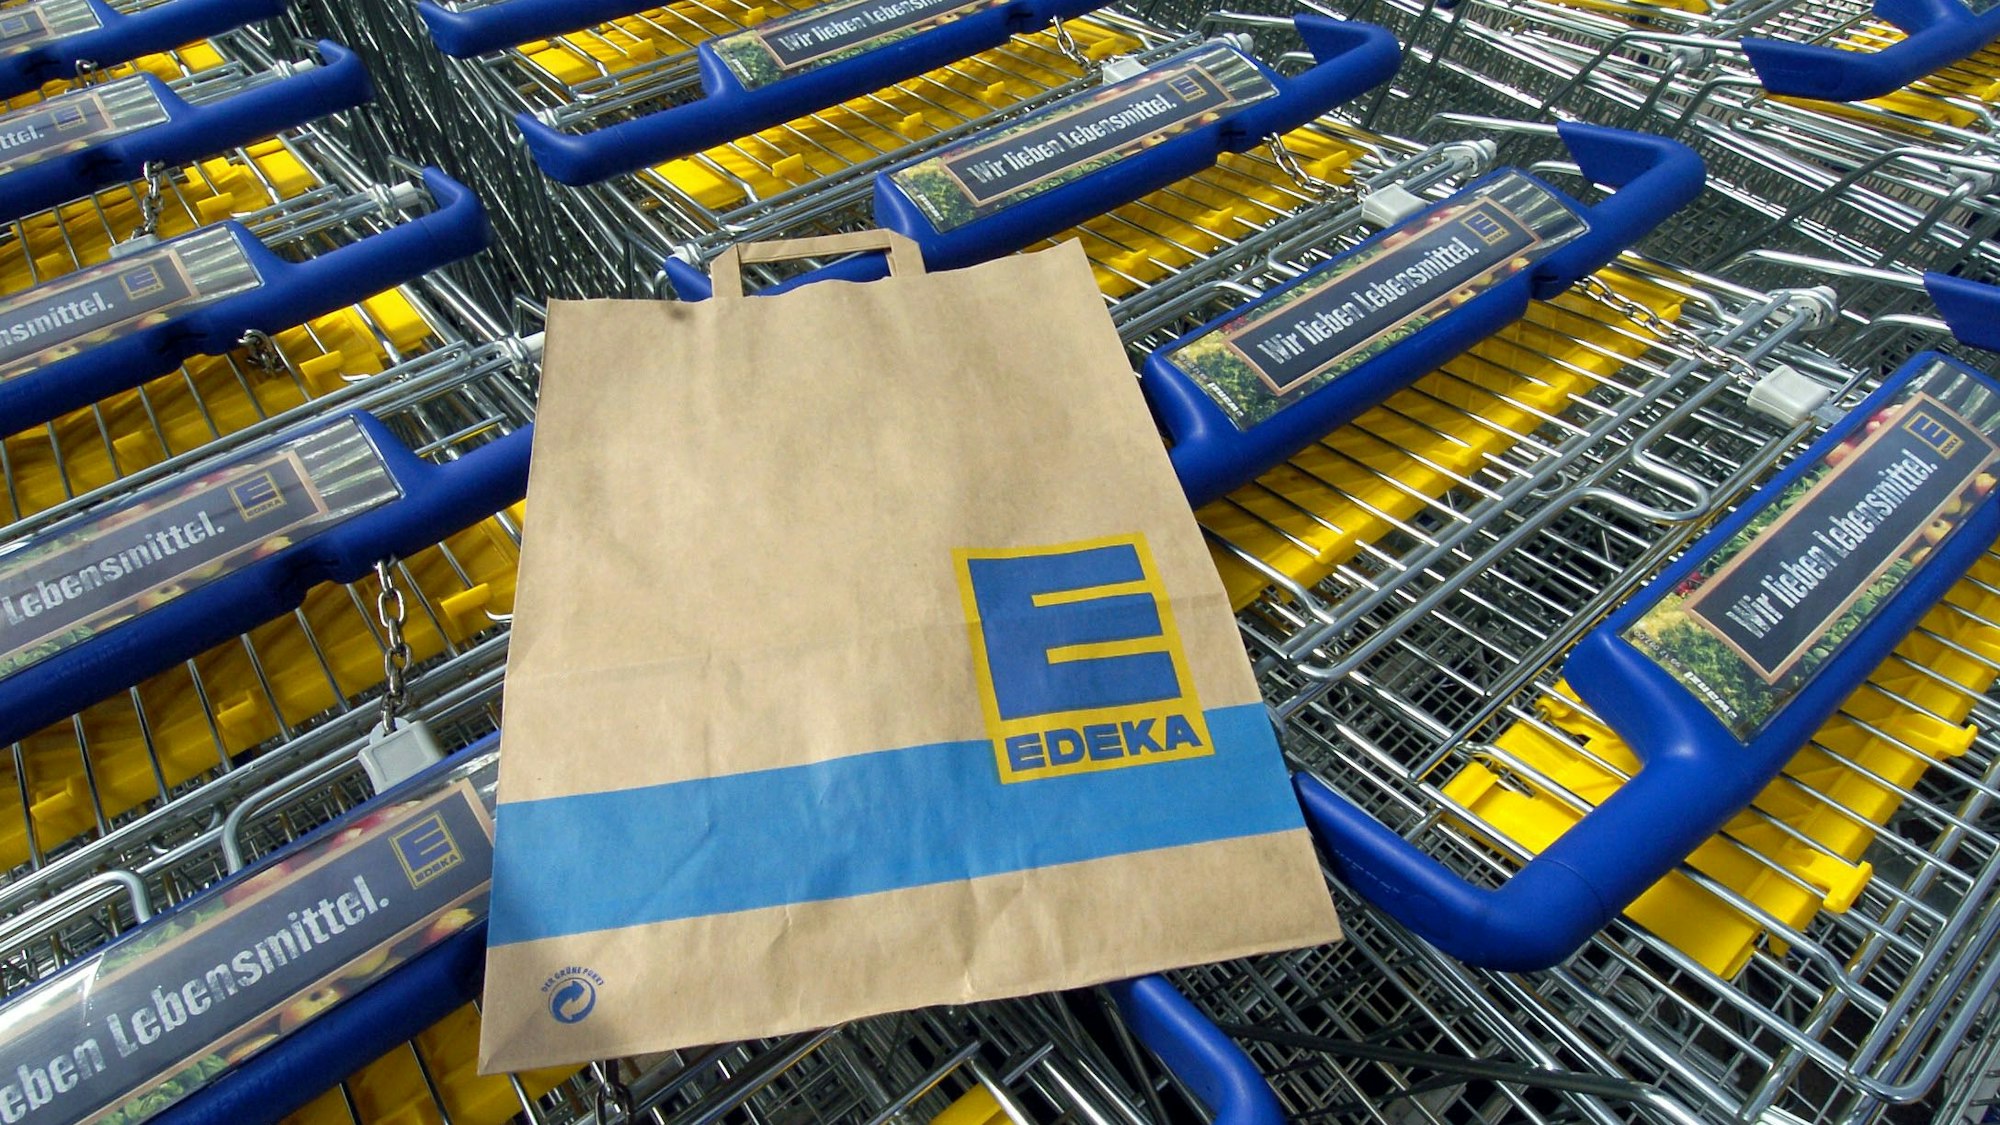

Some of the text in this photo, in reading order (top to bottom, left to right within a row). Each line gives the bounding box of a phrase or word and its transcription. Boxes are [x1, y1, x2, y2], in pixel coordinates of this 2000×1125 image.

[778, 0, 942, 51] Wir lieben Lebens
[967, 93, 1178, 184] Wir lieben Lebensmittel.
[1257, 236, 1480, 365] Wir lieben Lebensmittel.
[3, 511, 225, 626] Lebensmittel.
[1725, 448, 1938, 639] Wir lieben Lebensmittel.
[1004, 714, 1204, 772] EDEKA
[0, 875, 390, 1125] eben Lebensmittel.
[541, 978, 556, 992] DER
[554, 966, 581, 979] GRÜNE
